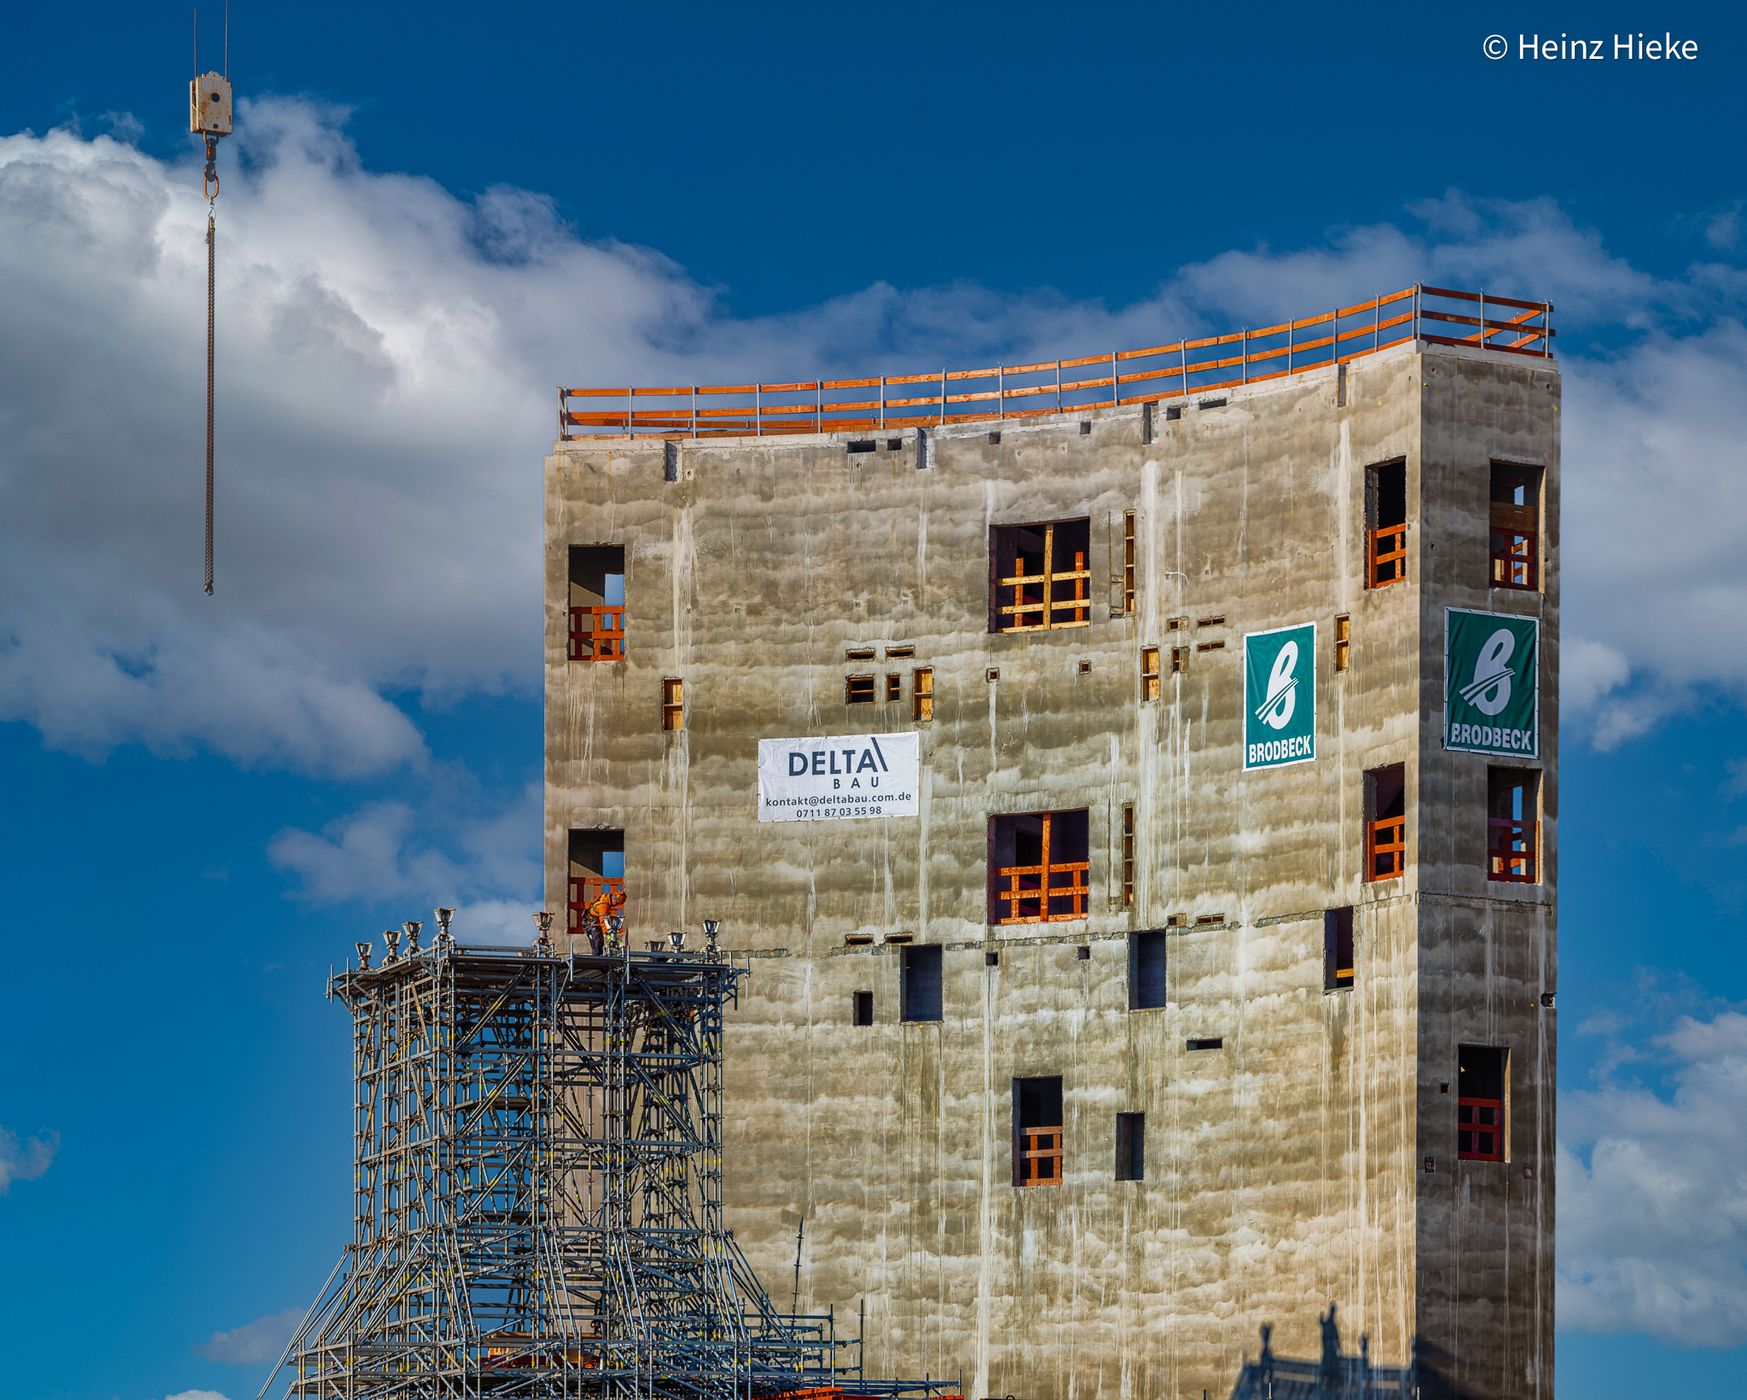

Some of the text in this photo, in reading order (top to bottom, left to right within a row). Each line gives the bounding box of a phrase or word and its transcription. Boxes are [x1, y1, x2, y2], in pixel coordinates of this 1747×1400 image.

[1451, 722, 1532, 751] BRODBECK
[1249, 734, 1312, 764] BRODBECK
[833, 776, 879, 790] BAU
[765, 791, 912, 807] kontakt@deltabau.com.de
[796, 805, 882, 818] 0711 87 03 55 98
